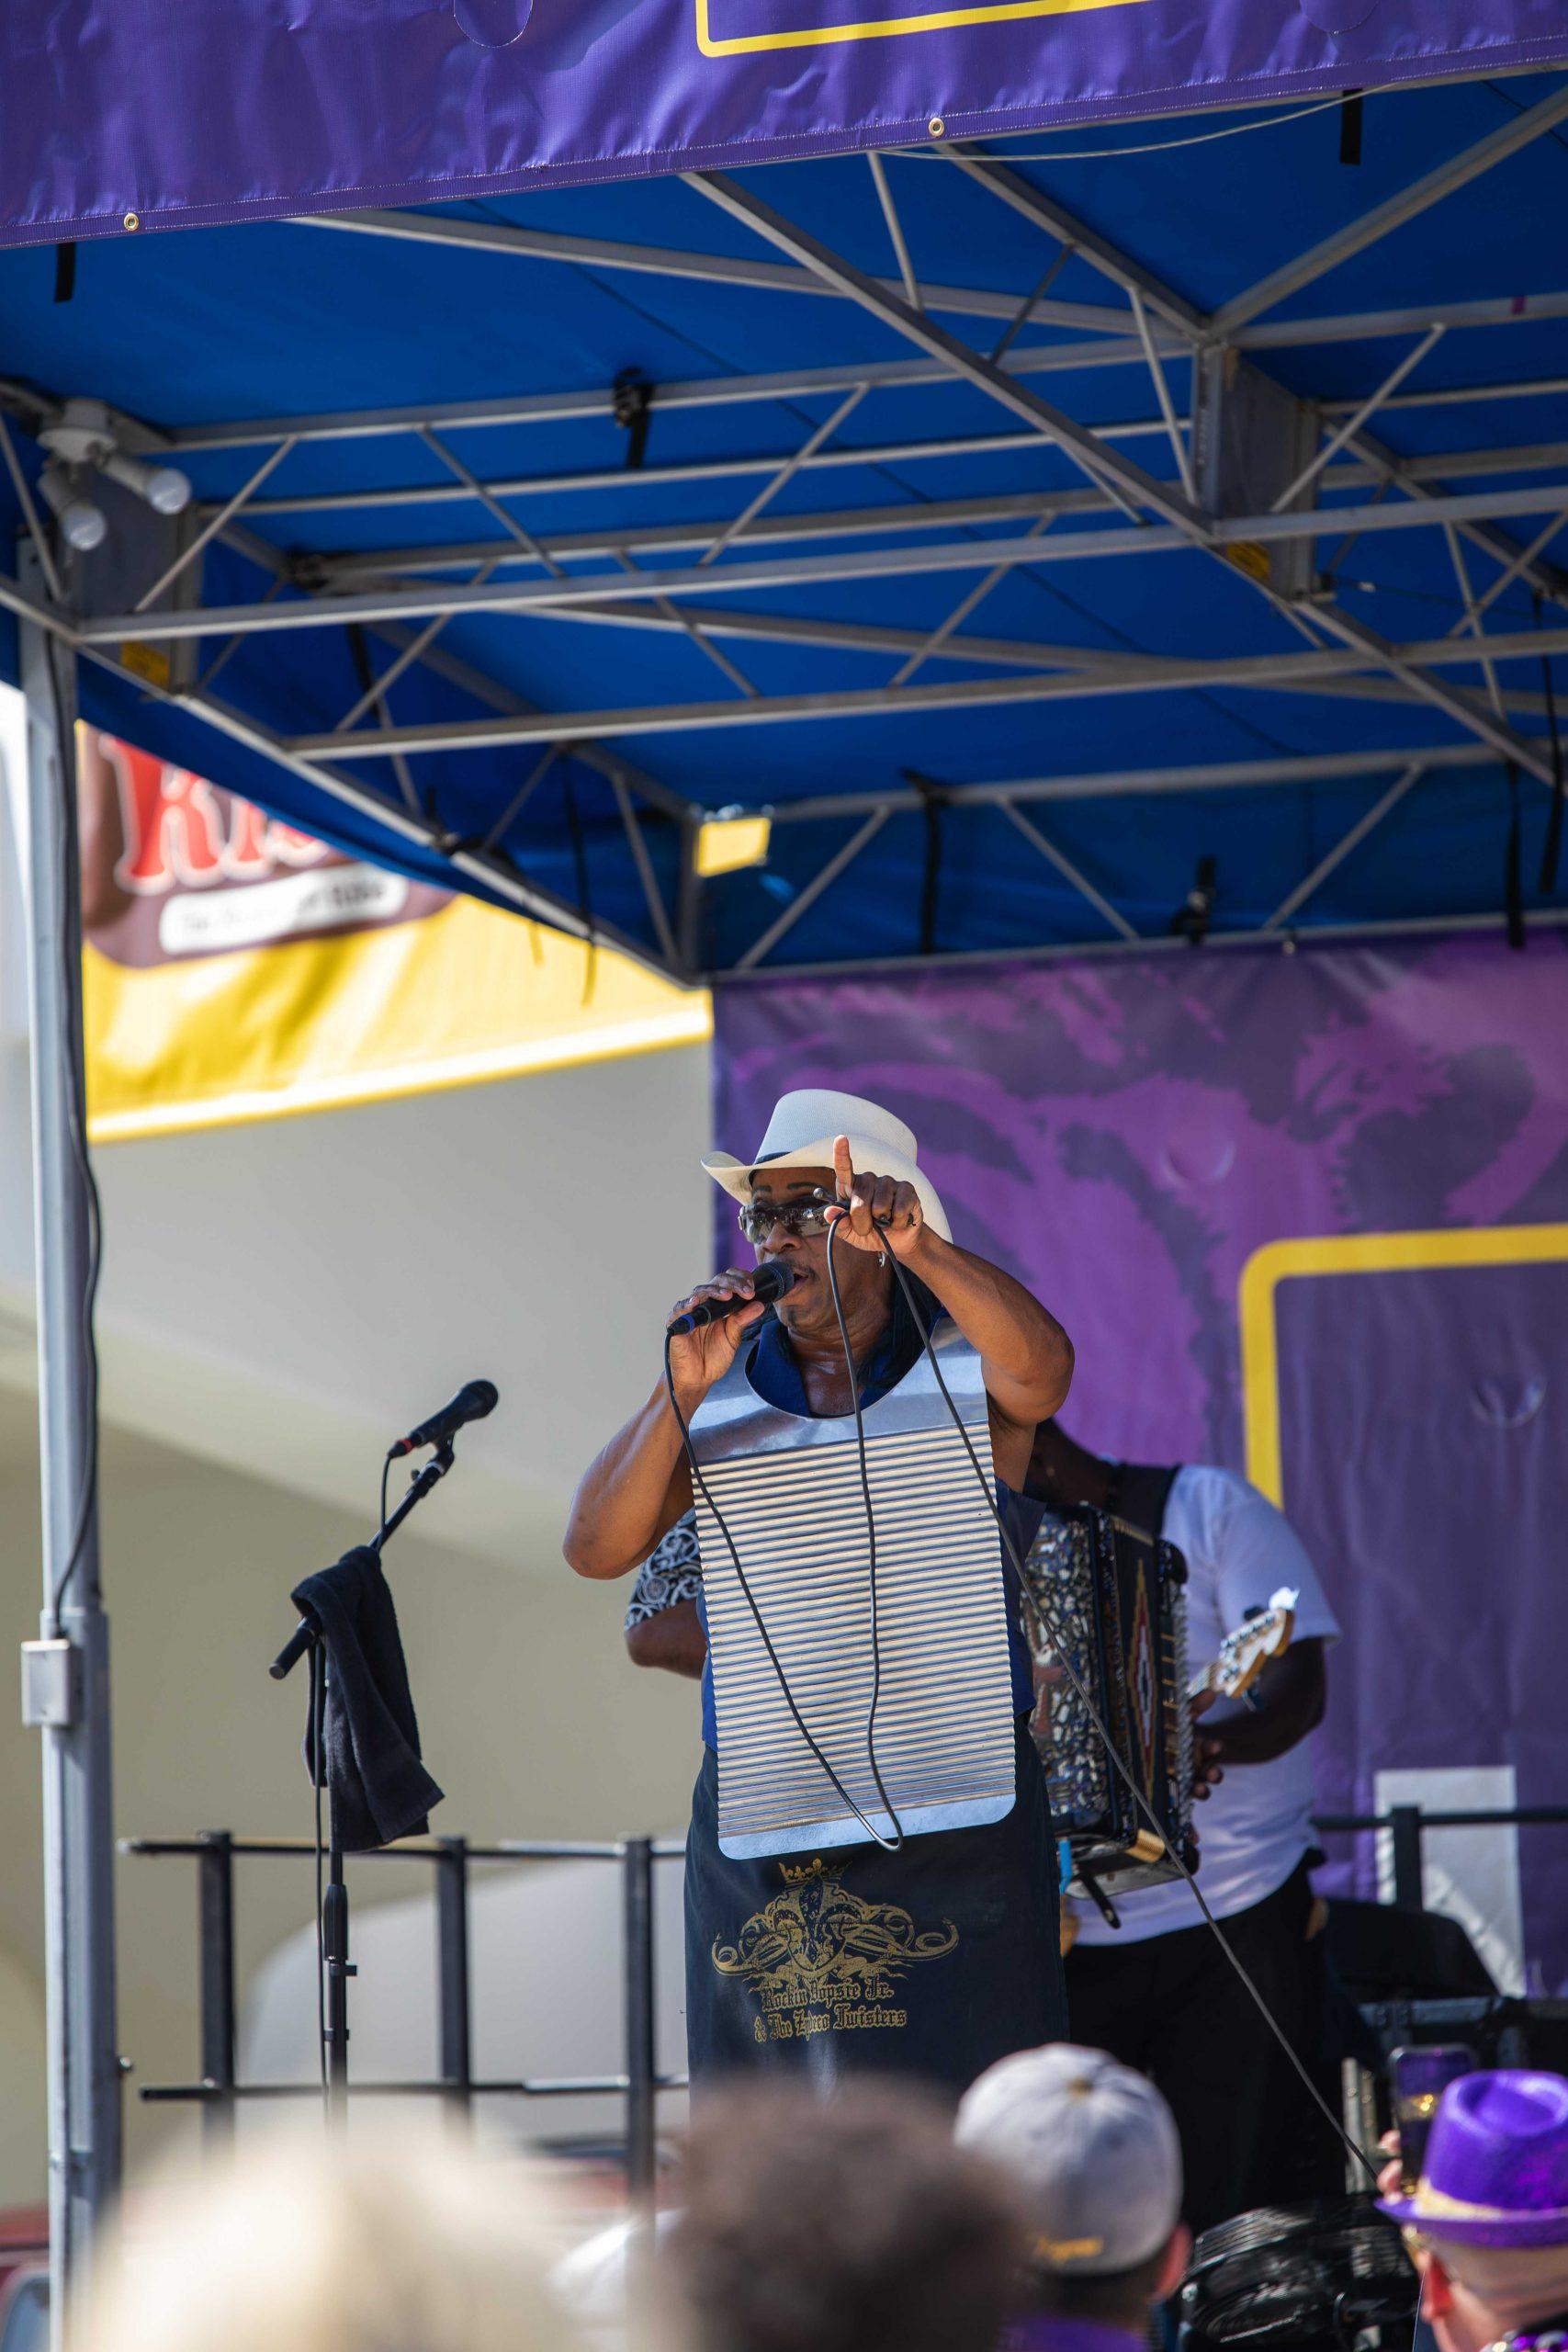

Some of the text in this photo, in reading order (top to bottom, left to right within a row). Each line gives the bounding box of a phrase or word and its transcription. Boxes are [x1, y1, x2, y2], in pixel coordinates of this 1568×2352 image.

[761, 1974, 895, 2012] Rockin Dopsie Jr.
[754, 2003, 907, 2041] & The Zydeco Twisters
